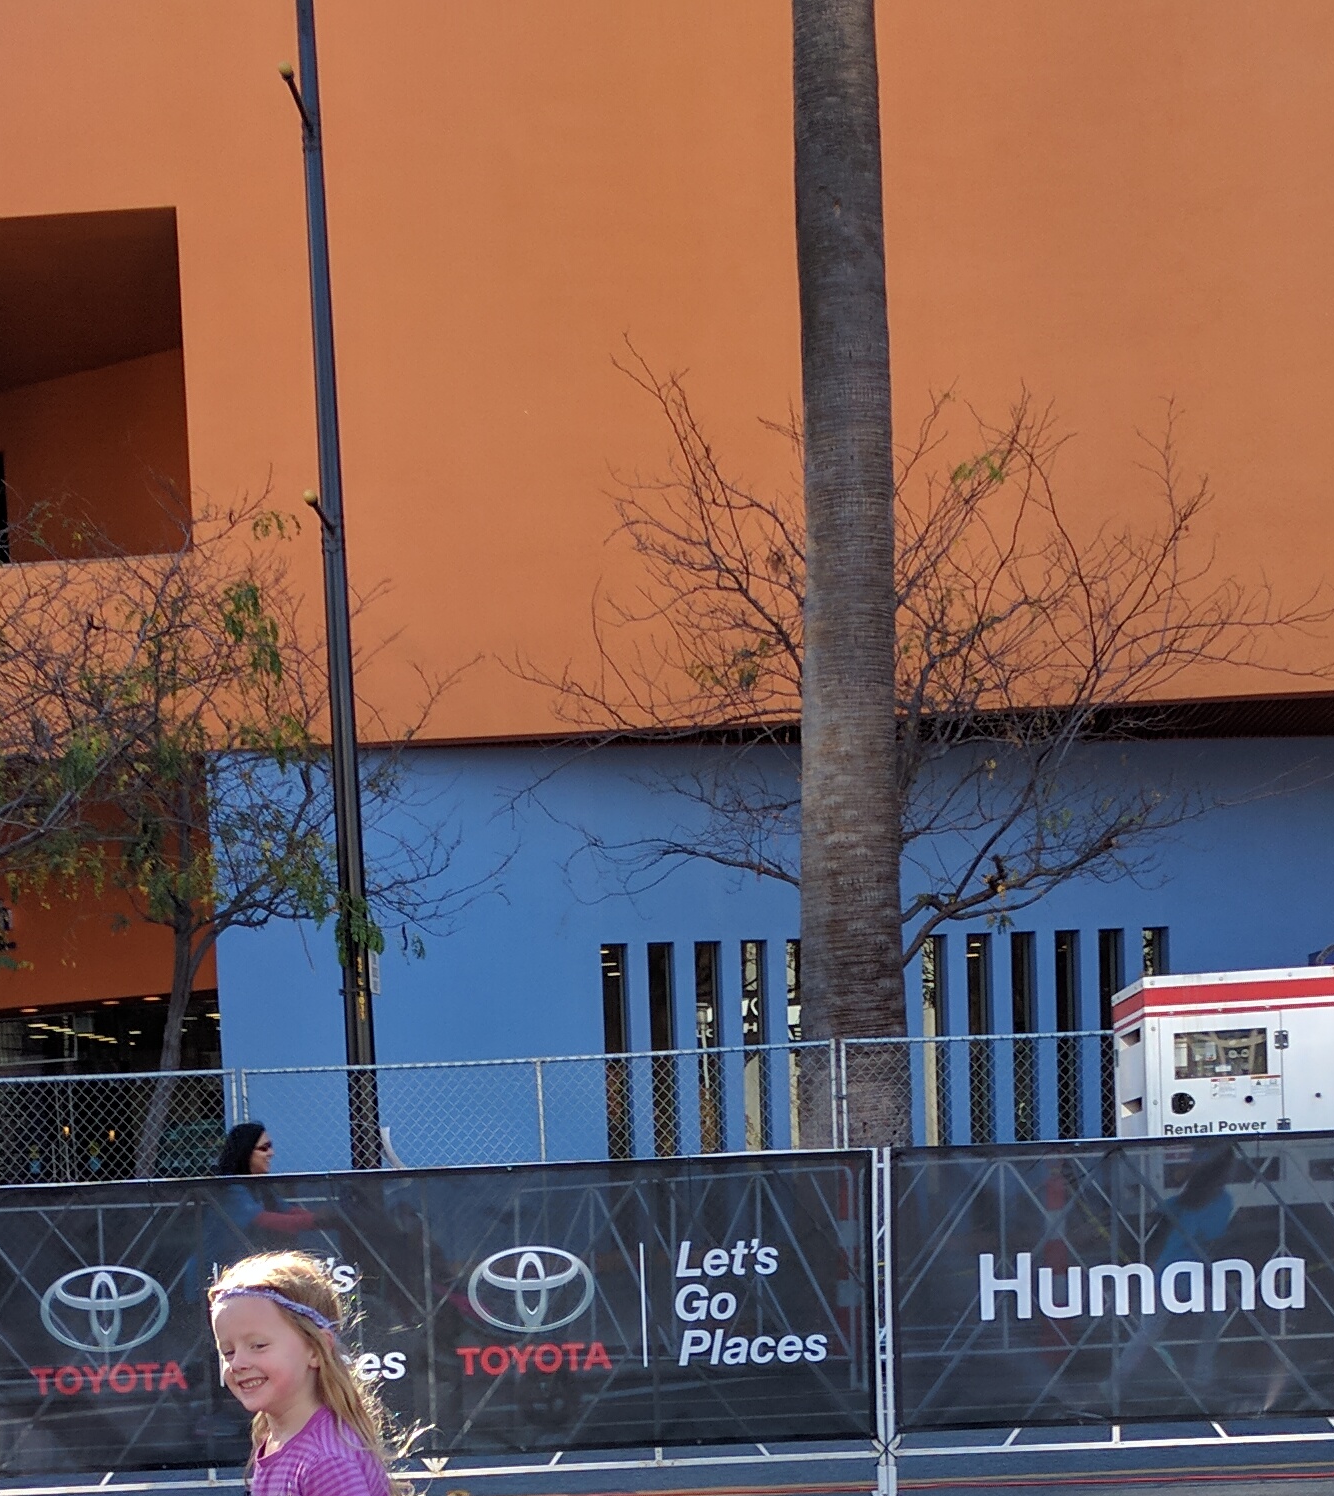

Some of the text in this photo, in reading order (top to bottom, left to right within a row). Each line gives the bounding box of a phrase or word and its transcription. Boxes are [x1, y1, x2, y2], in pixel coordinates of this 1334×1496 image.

[1164, 1119, 1268, 1136] Rental Power
[675, 1238, 779, 1278] Let's
[675, 1283, 737, 1322] Go
[979, 1252, 1306, 1321] Humana
[456, 1341, 612, 1376] TOYOTA
[678, 1328, 828, 1367] Places
[29, 1360, 189, 1396] TOYOTA
